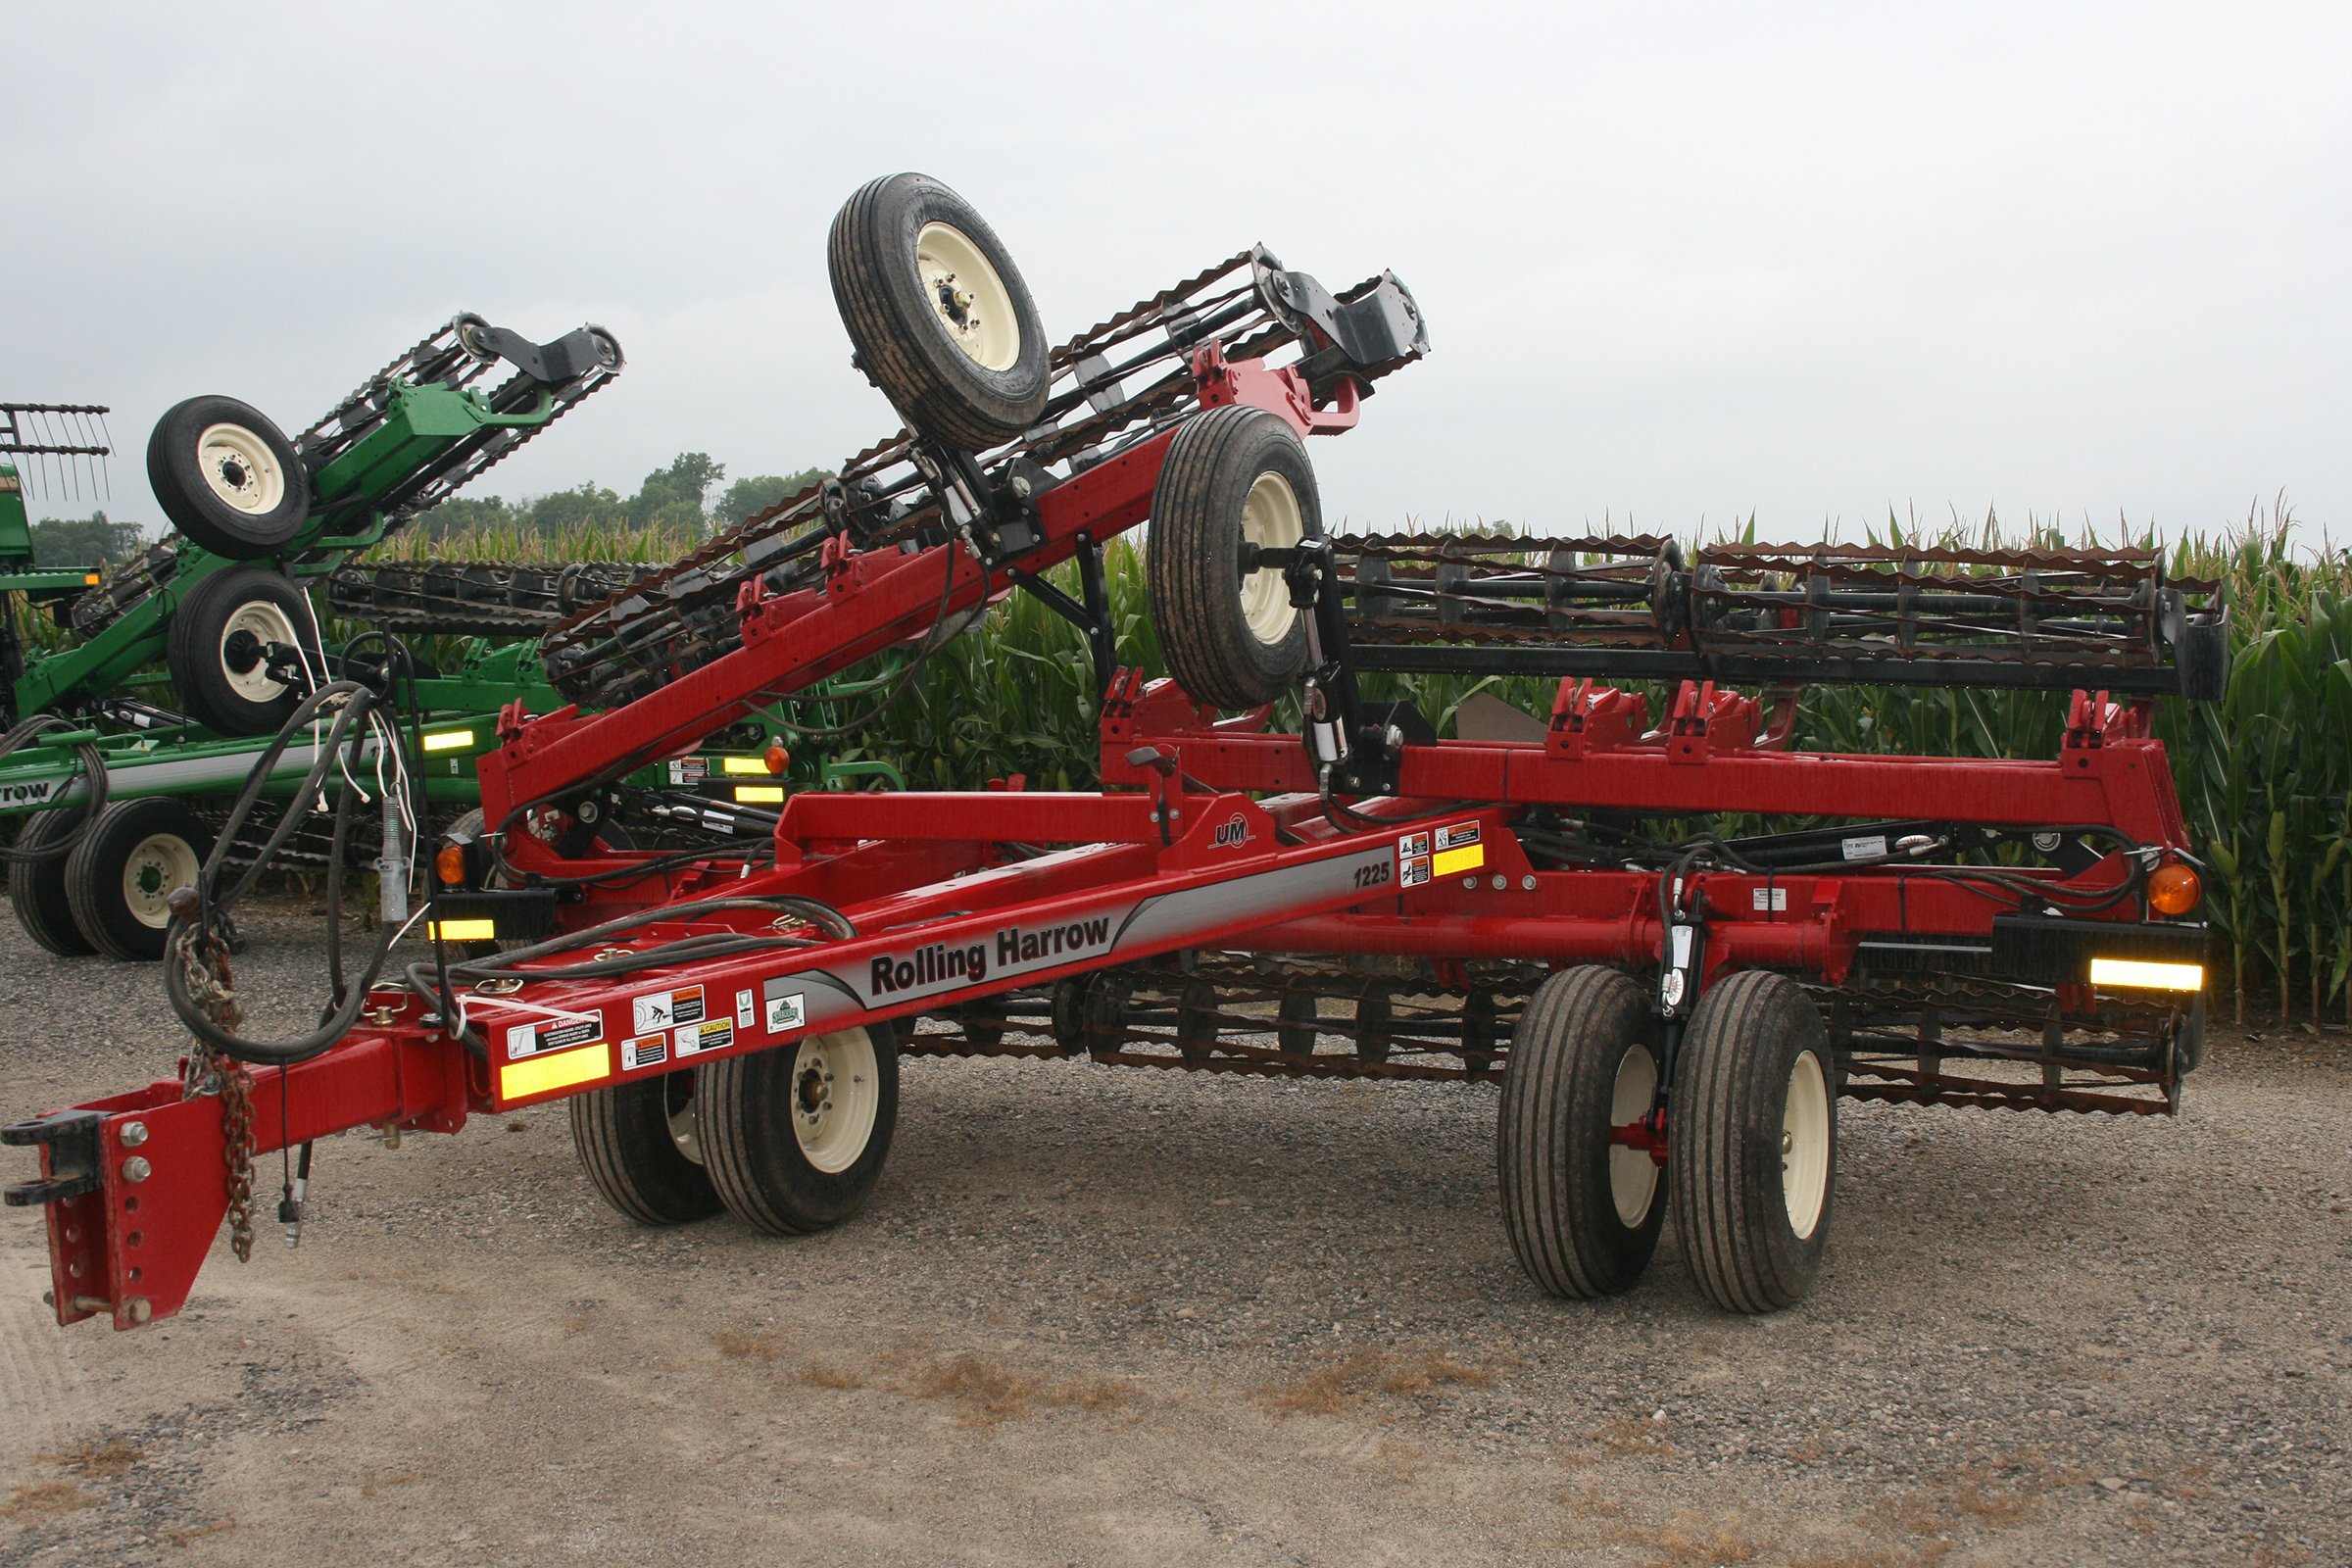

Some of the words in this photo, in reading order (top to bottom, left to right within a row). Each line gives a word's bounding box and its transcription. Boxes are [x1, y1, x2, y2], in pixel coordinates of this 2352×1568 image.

[1216, 821, 1246, 844] UM
[1353, 861, 1390, 889] 1225
[870, 944, 987, 997] Rolling
[997, 917, 1109, 967] Harrow
[706, 1021, 730, 1033] CAUTION
